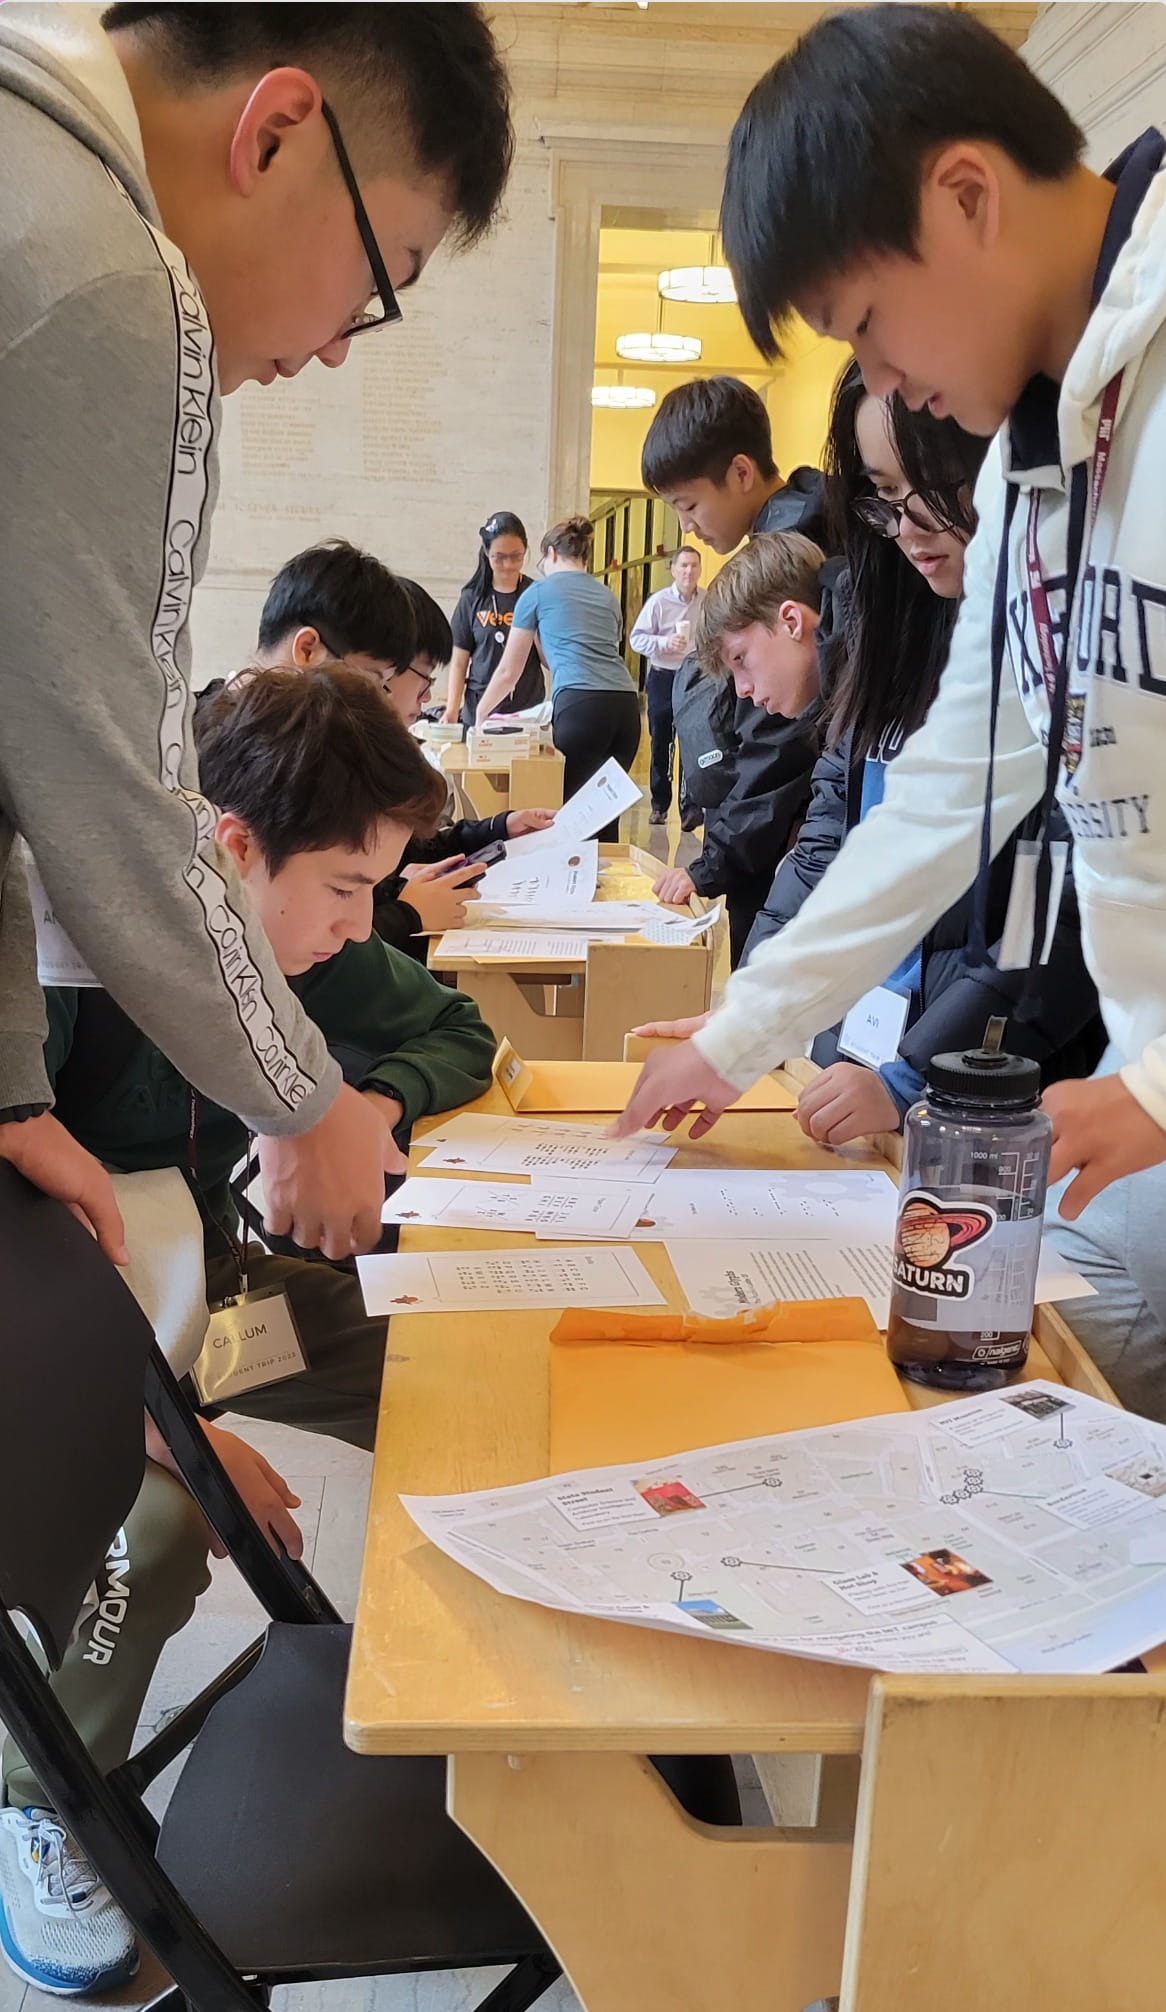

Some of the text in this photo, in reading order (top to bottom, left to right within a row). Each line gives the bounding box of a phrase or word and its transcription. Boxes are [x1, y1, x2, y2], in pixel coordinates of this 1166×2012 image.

[171, 265, 207, 476] Calvin Klein
[154, 520, 195, 709] Calvin Klein
[970, 1151, 988, 1160] 1000
[893, 1255, 964, 1293] SATURN
[82, 1526, 130, 1665] RMOUR
